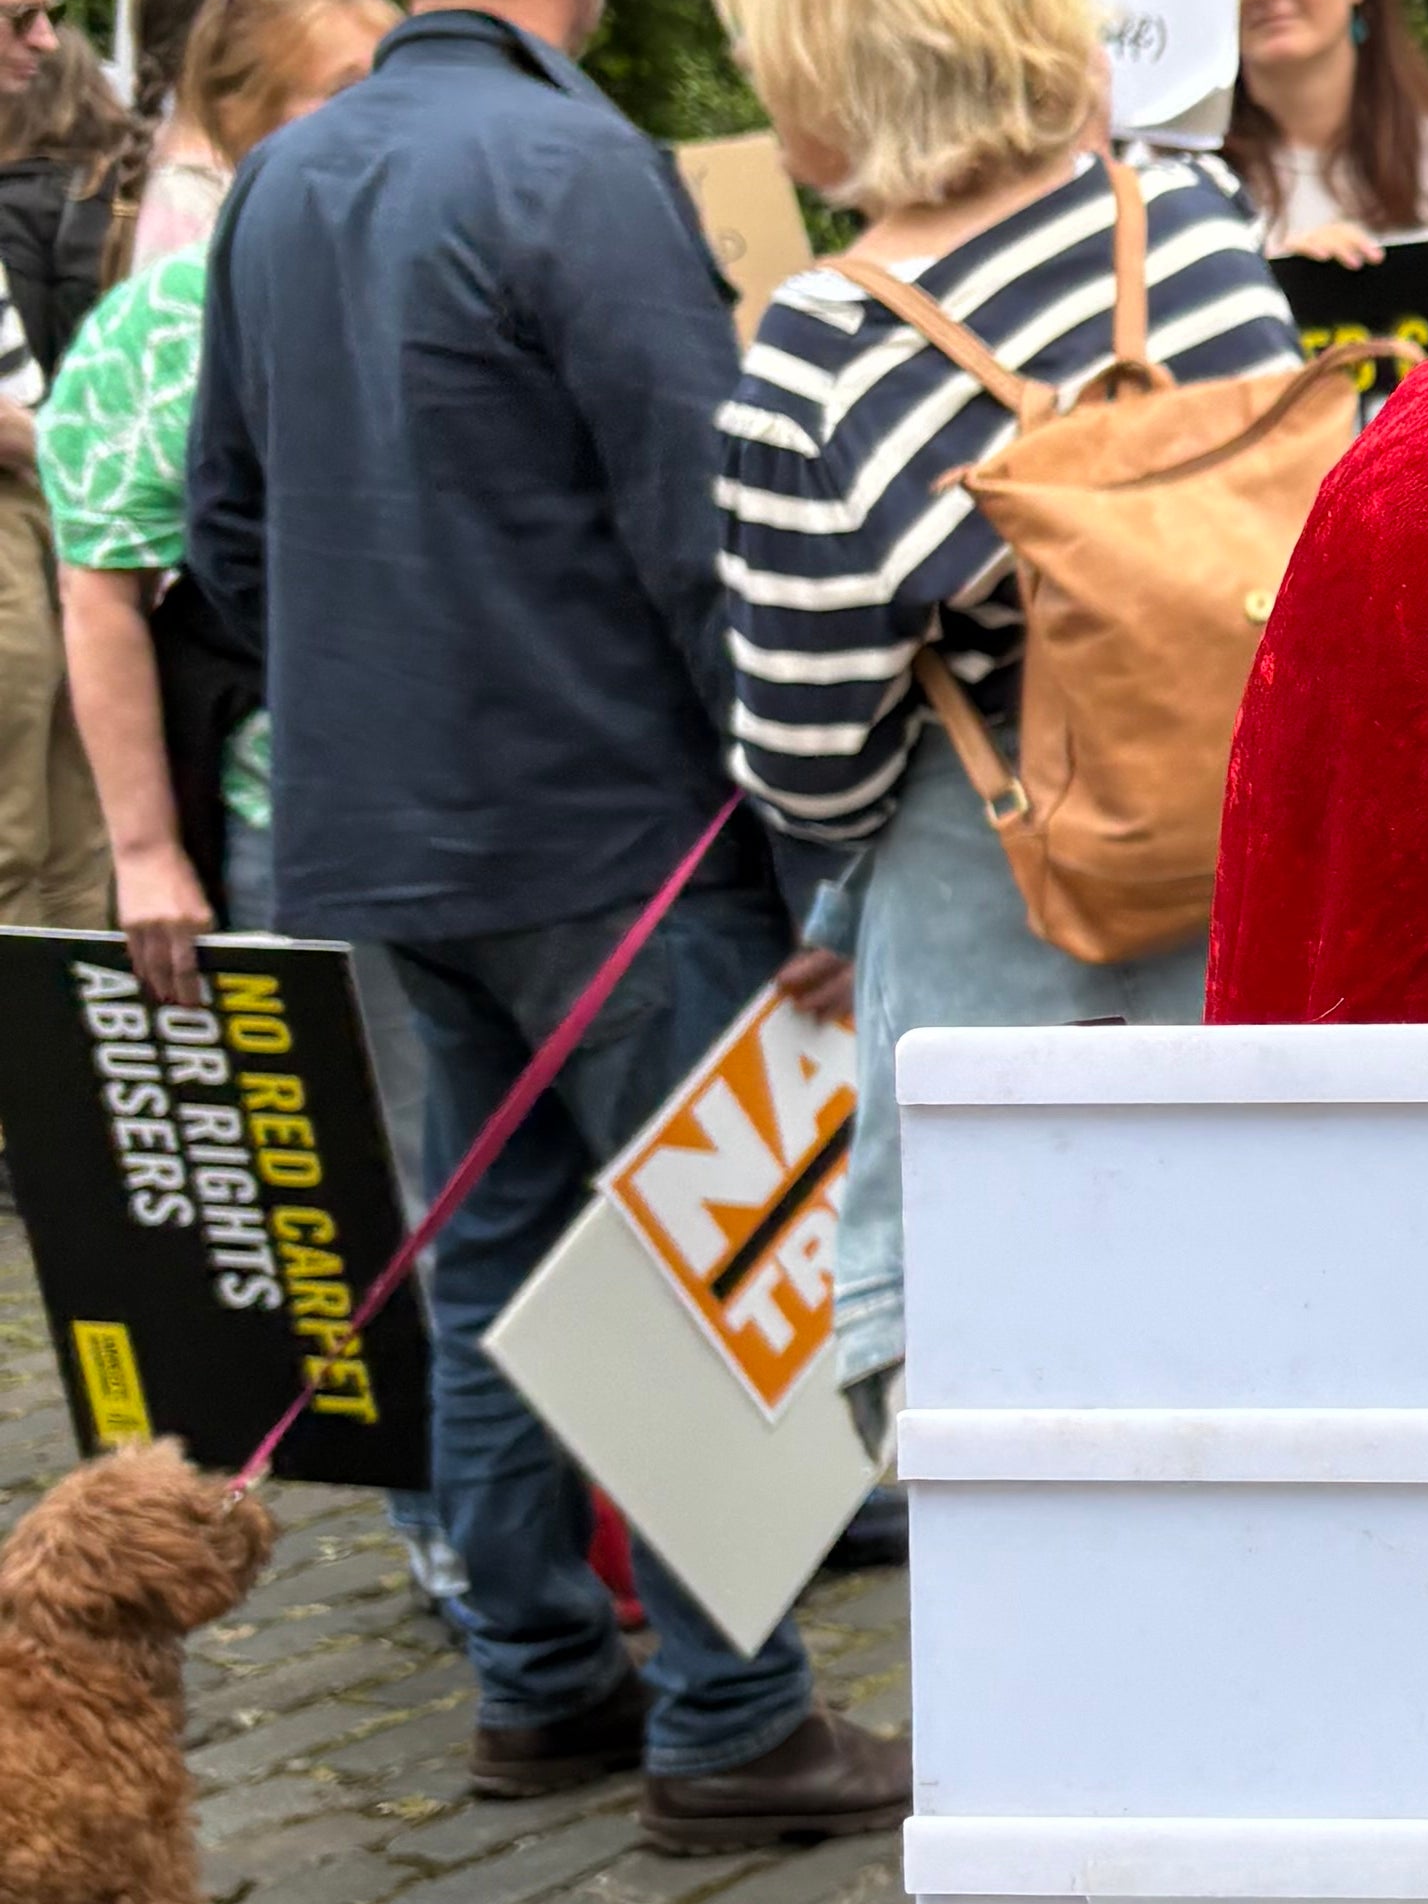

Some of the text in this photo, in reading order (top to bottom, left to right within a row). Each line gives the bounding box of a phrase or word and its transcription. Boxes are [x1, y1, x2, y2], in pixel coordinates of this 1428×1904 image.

[75, 960, 195, 1229] ABUSERS
[181, 1104, 283, 1310] RIGHTS
[217, 972, 378, 1424] NO RED CARPET
[725, 1174, 848, 1355] TR
